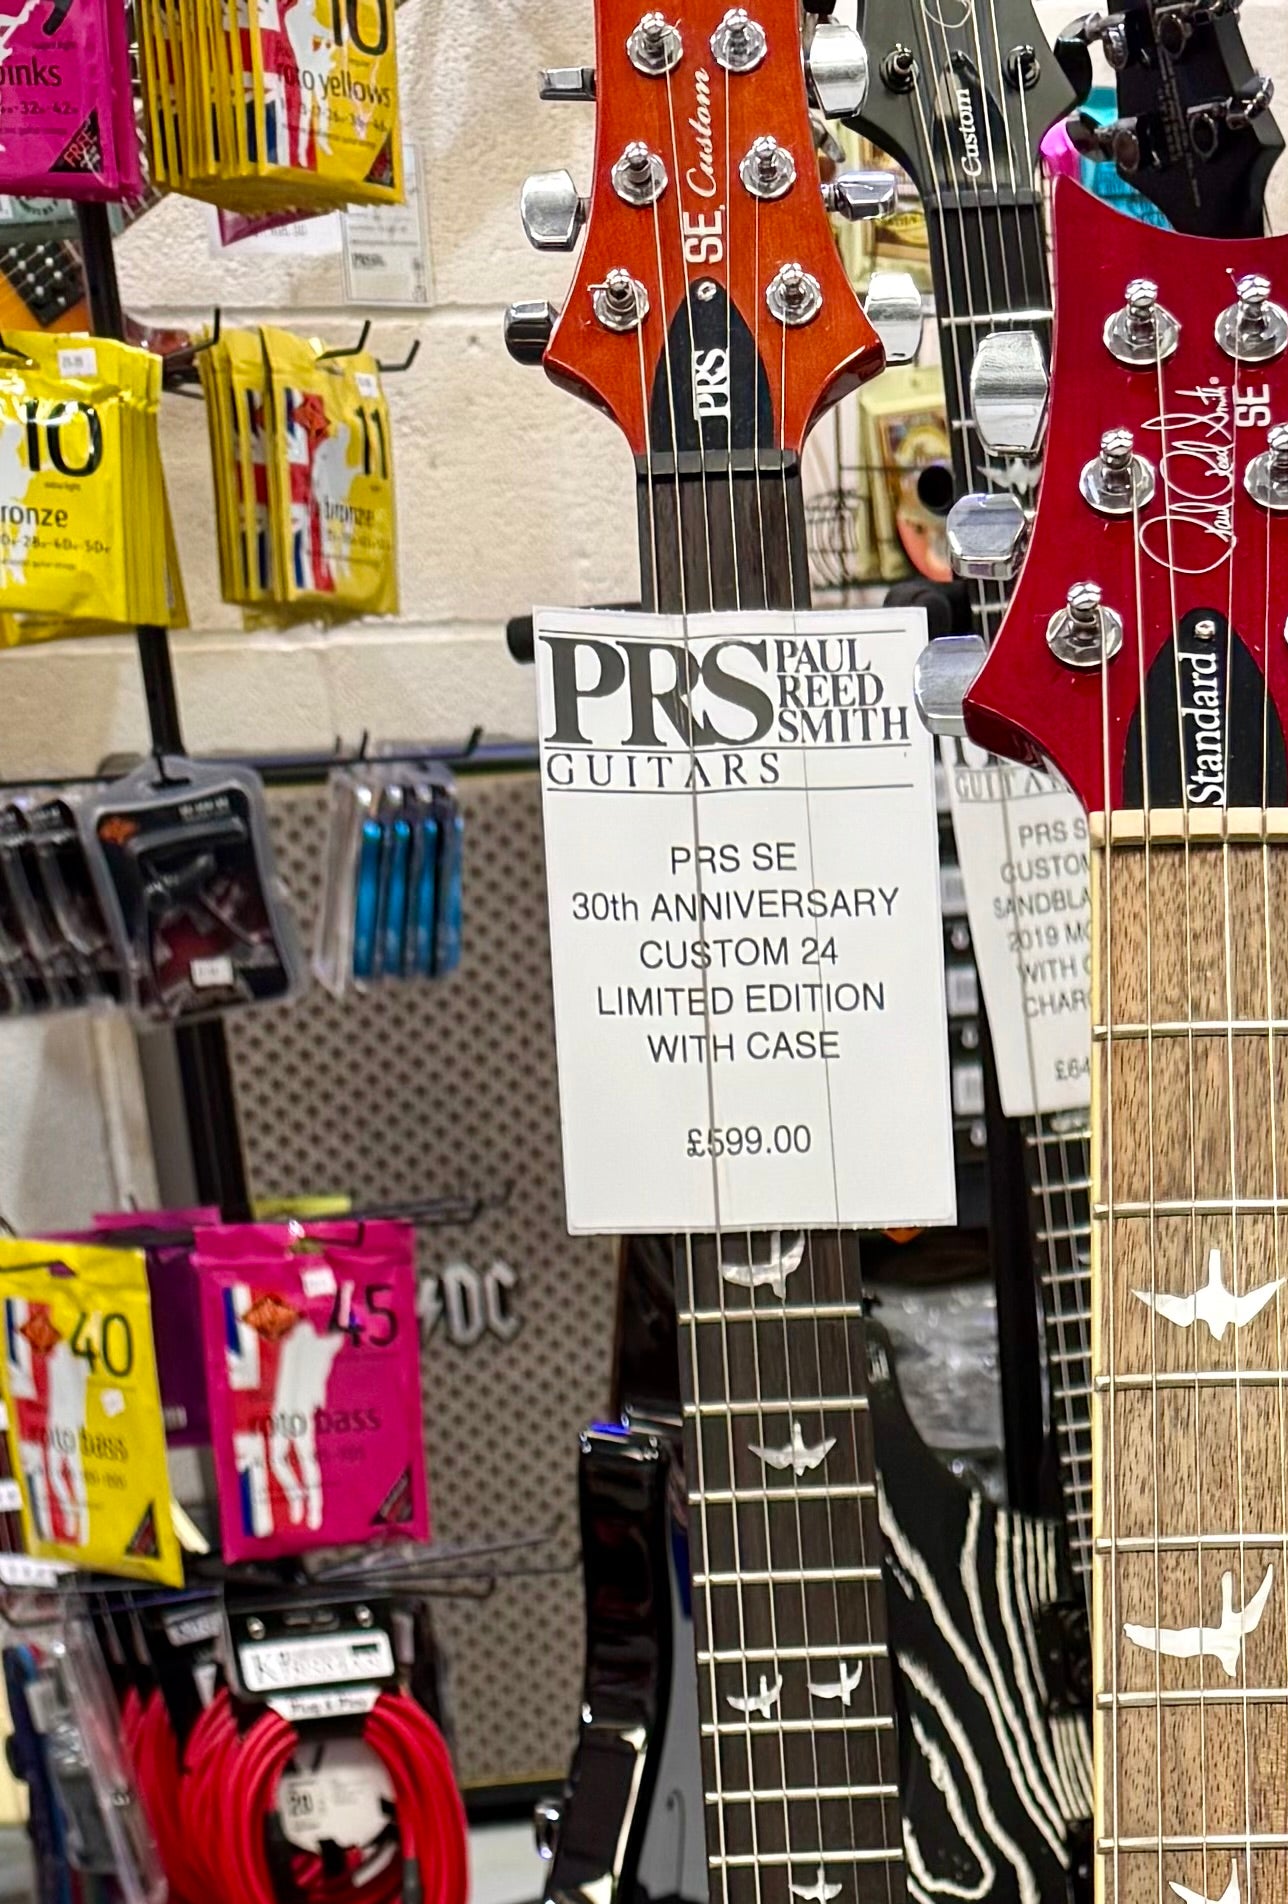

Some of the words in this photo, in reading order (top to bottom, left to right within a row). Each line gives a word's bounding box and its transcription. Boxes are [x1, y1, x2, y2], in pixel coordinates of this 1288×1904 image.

[318, 69, 390, 108] yellows
[686, 68, 717, 198] Custom
[960, 88, 982, 178] Custom
[683, 206, 725, 264] SE
[693, 348, 731, 421] PRS
[1235, 383, 1271, 427] SE
[26, 399, 104, 477] 10
[355, 405, 387, 480] 11
[774, 638, 871, 673] PAUL
[539, 636, 774, 747] PRS
[777, 674, 884, 708] REED
[778, 706, 910, 744] SMITH
[1184, 651, 1224, 806] Standard
[547, 752, 780, 789] GUITARS
[1018, 820, 1067, 848] PRS
[671, 844, 740, 875] PRS
[752, 842, 797, 871] SE
[572, 892, 639, 922] 30th
[651, 887, 899, 922] ANNIVERSARY
[993, 886, 1091, 919] SANDBLA
[640, 936, 789, 968] CUSTOM
[801, 936, 839, 965] 24
[598, 985, 734, 1016] LIMITED
[746, 981, 885, 1013] EDITION
[648, 1033, 735, 1063] WITH
[747, 1031, 840, 1060] CASE
[685, 1124, 812, 1158] £599.00
[70, 1312, 134, 1377] 40
